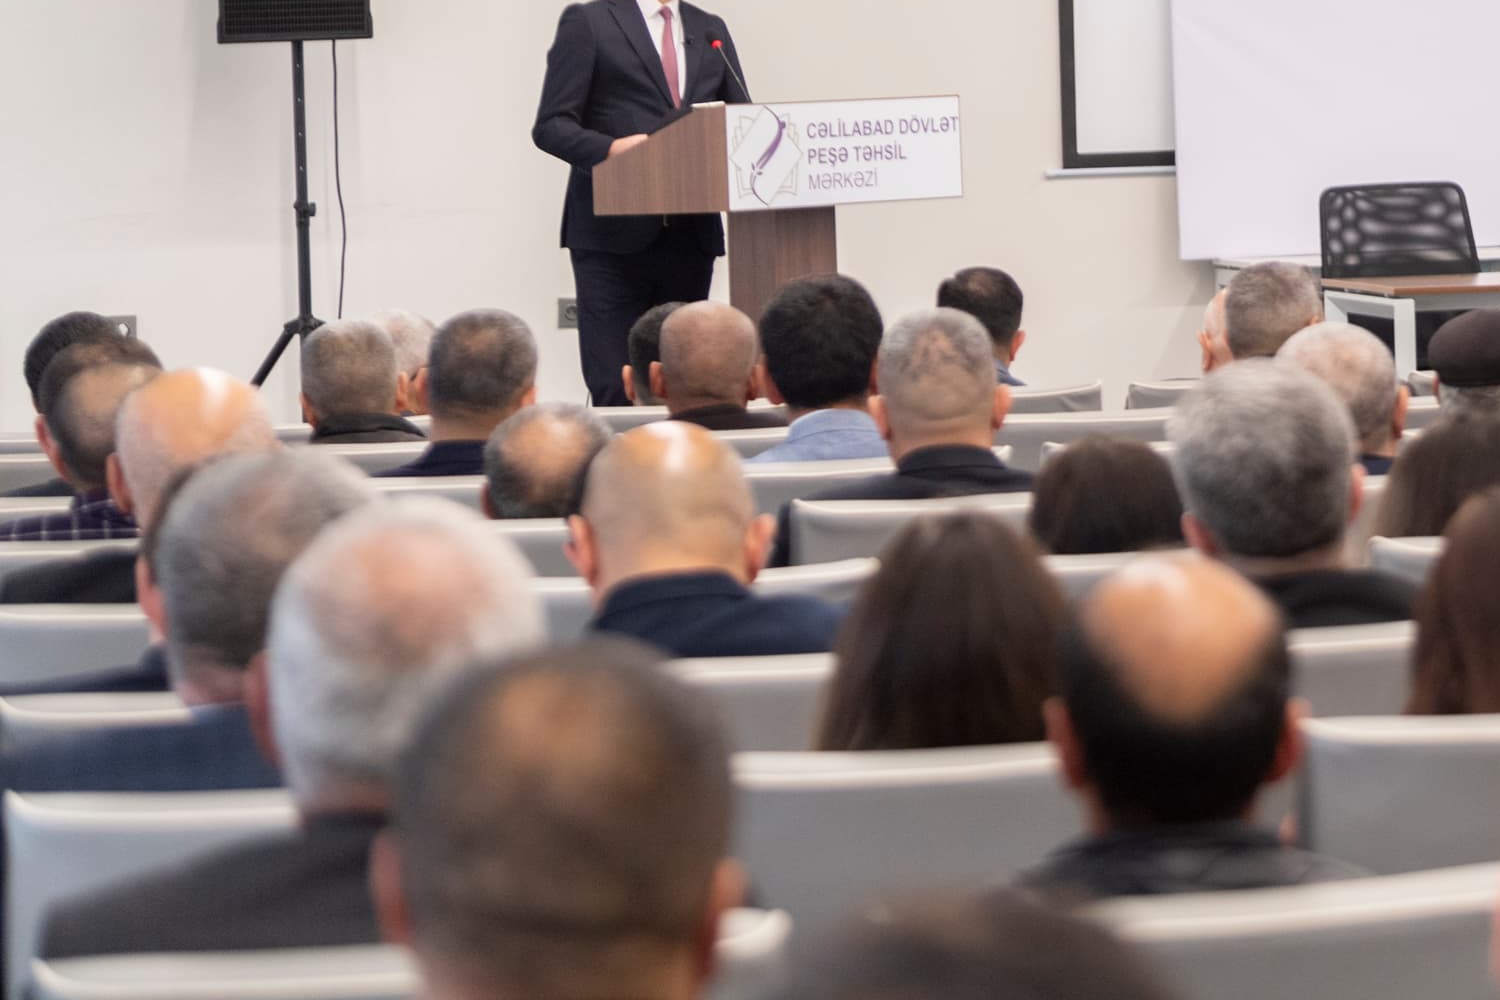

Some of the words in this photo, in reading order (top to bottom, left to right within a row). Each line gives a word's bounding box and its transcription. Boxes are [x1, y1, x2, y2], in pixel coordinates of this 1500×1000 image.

[806, 117, 895, 139] CƏLİLABAD
[899, 115, 959, 135] DÖVLƏT
[807, 146, 849, 167] PEŞƏ
[853, 140, 908, 162] TƏHSİL
[808, 168, 878, 190] MƏRKƏZİ
